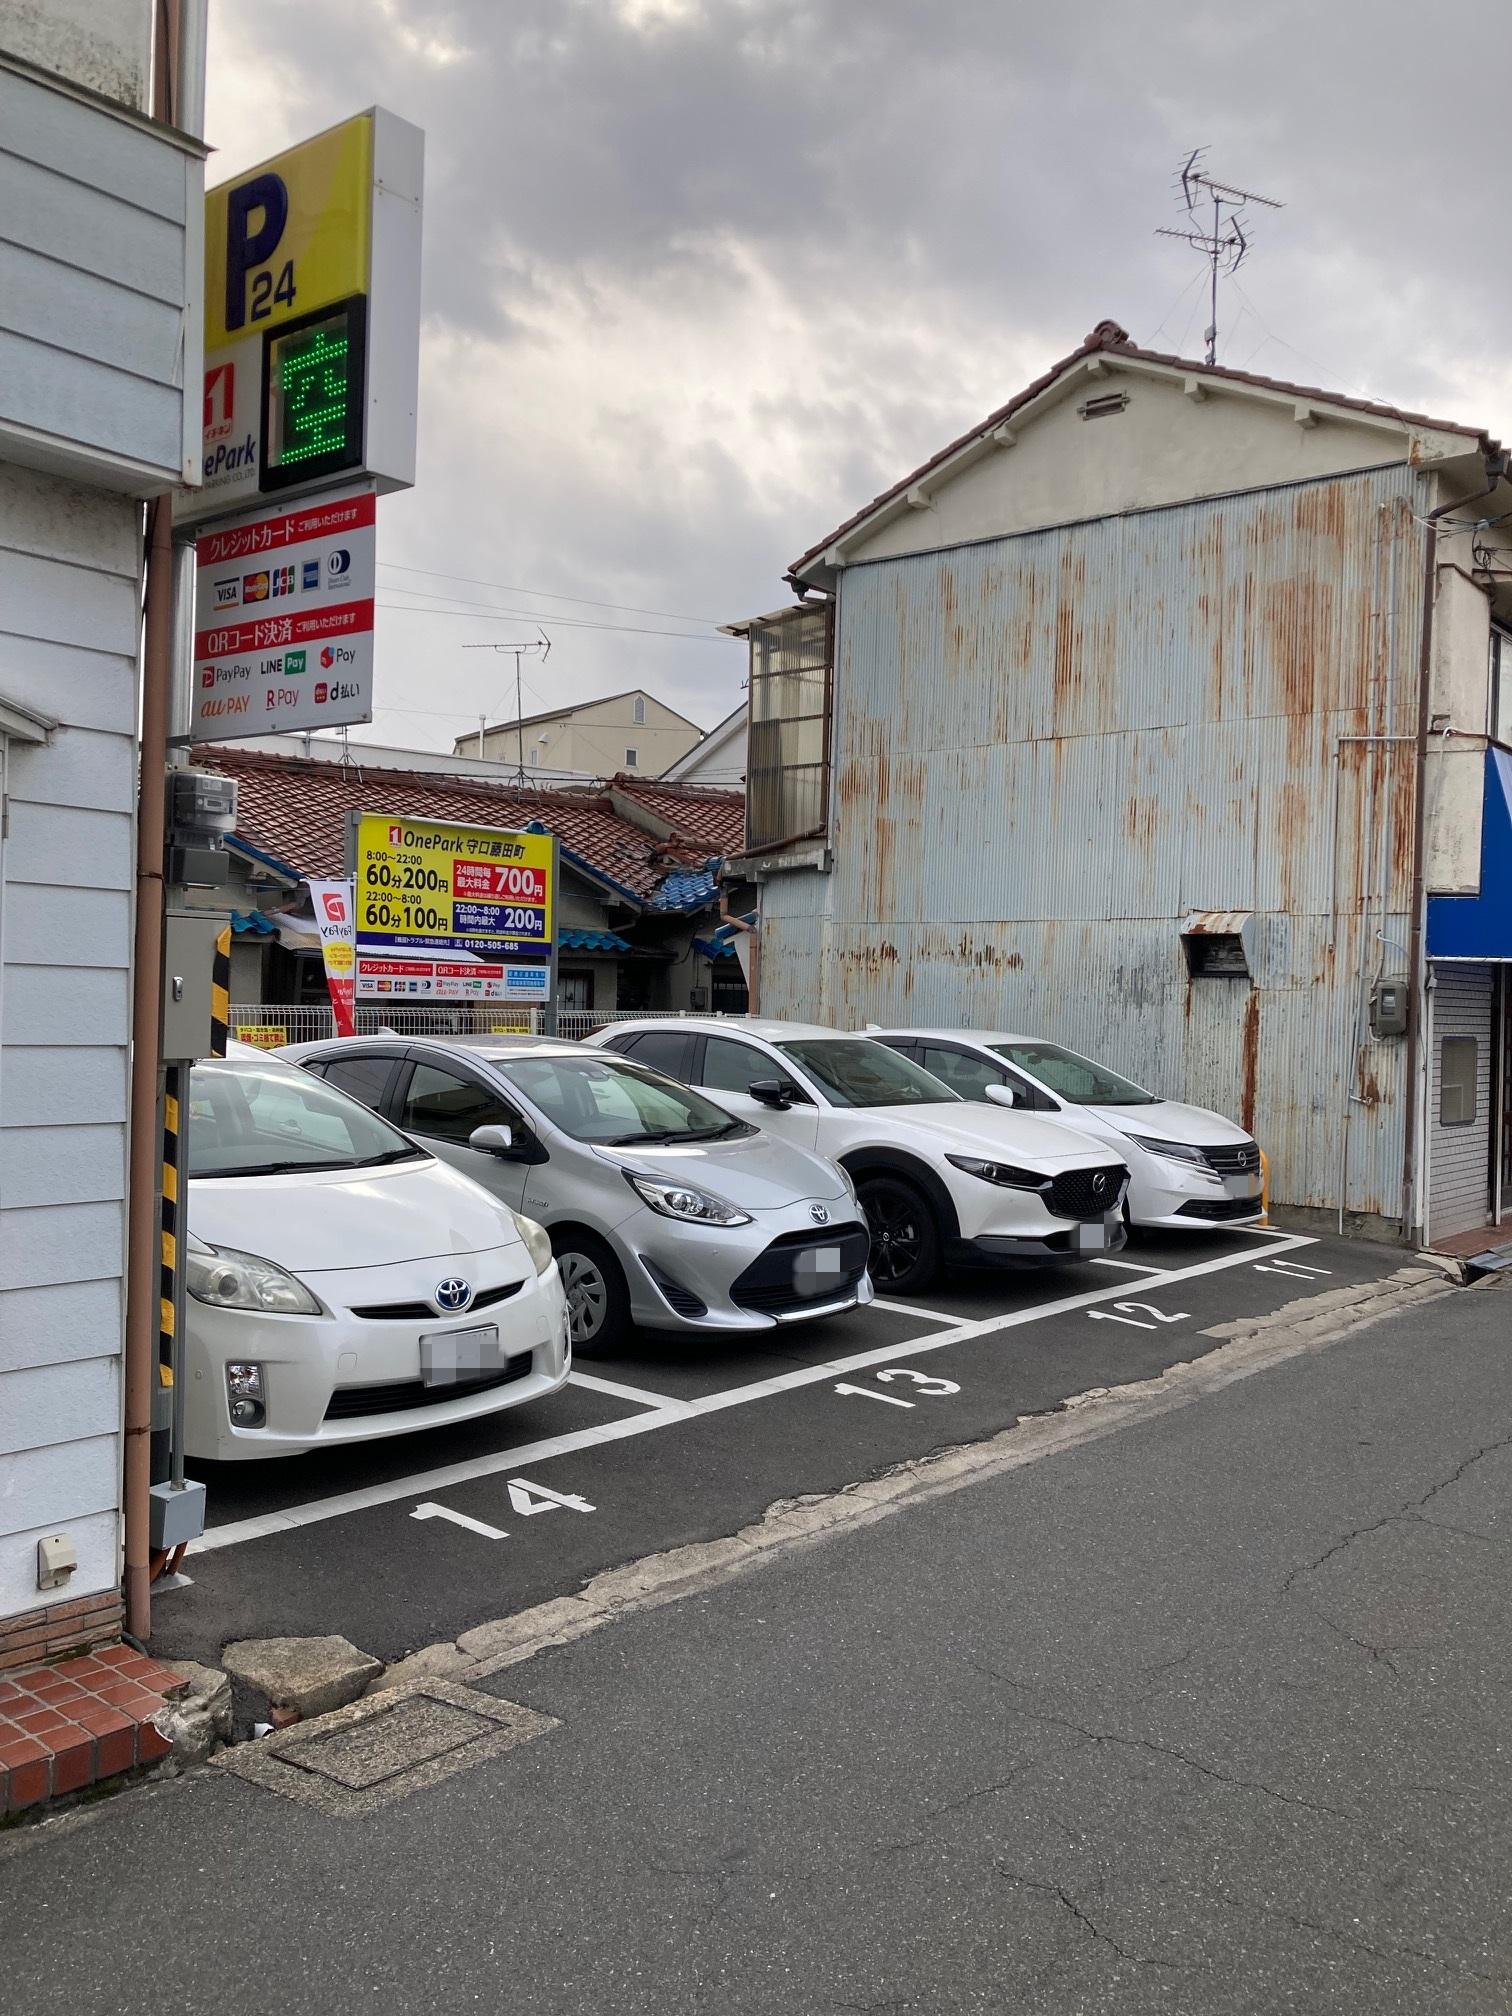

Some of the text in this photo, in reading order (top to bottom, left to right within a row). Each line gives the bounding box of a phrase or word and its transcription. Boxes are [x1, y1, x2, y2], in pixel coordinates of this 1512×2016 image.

[225, 172, 288, 333] P
[251, 260, 296, 322] 24
[282, 332, 348, 465] 空
[203, 434, 256, 477] ePark
[210, 507, 358, 561] クレジットカード ご利用いただけます
[217, 587, 237, 602] VISA
[208, 612, 356, 654] QRコード決済 ご利用いただけます
[216, 648, 356, 684] PayPay LINE Pay Pay
[201, 698, 226, 718] au
[226, 694, 250, 715] PAY
[278, 687, 299, 708] Pay
[404, 830, 462, 853] OnePark
[466, 839, 526, 859] 守口藤田町
[366, 863, 448, 893] 60分200円
[456, 865, 543, 897] 24時間毎 700円
[456, 876, 490, 890] 最大料金
[365, 903, 448, 931] 60分100円
[459, 914, 495, 926] 時間内最大
[504, 908, 543, 931] 200円
[464, 939, 519, 950] 0120-505-685
[361, 962, 404, 973] クレジットカード
[1252, 1258, 1334, 1280] 11
[1086, 1301, 1191, 1330] 12
[834, 1367, 961, 1408] 13
[409, 1477, 597, 1540] 14
